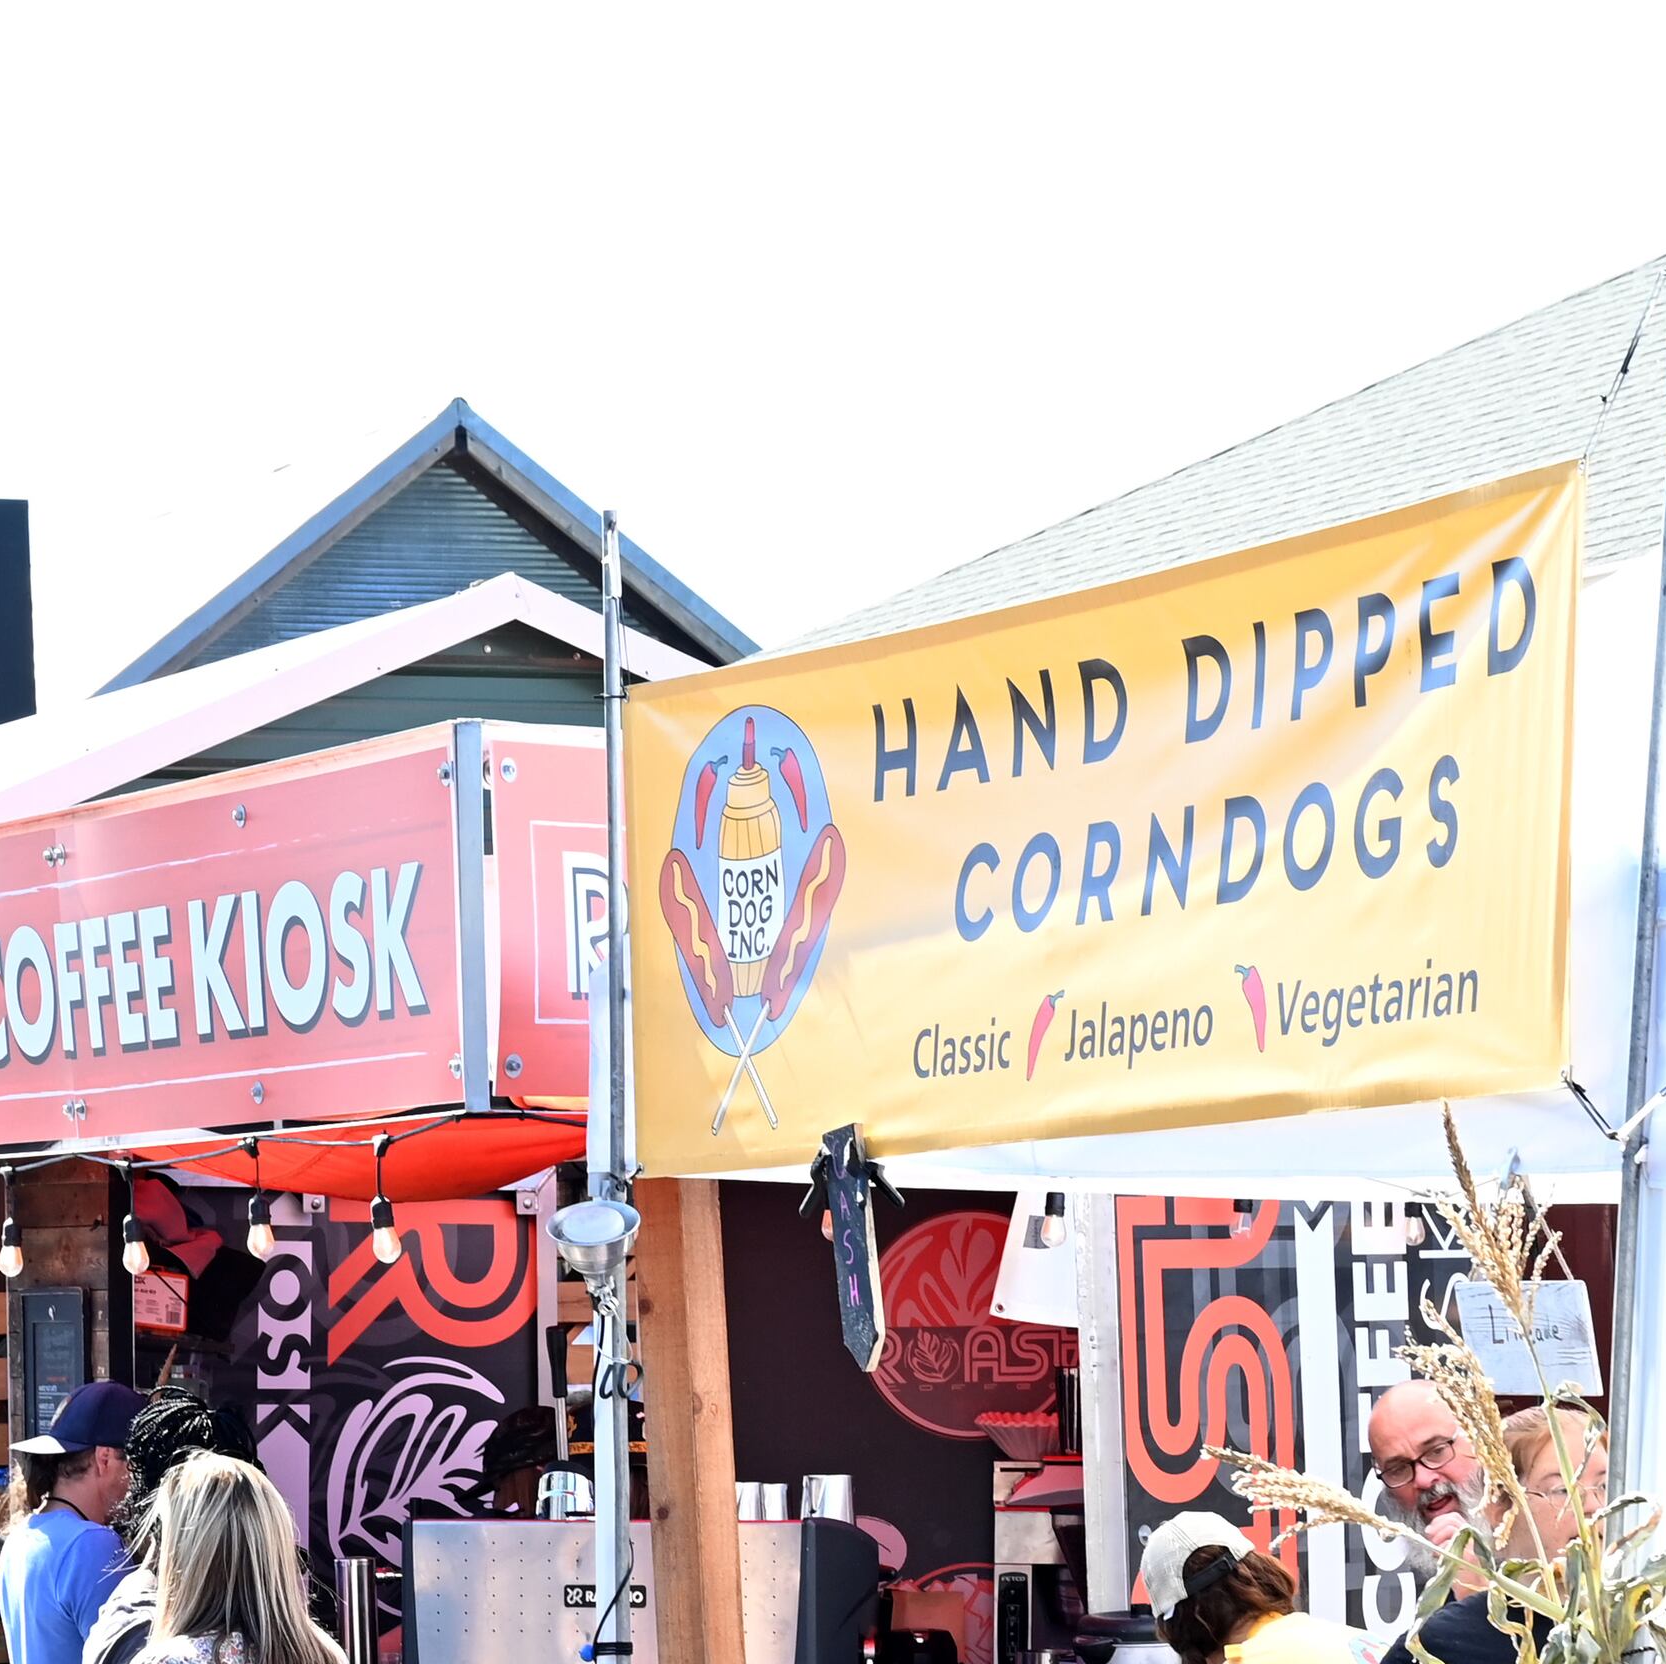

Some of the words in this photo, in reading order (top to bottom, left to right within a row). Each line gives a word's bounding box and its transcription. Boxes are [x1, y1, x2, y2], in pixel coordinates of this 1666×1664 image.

[873, 657, 1129, 803] HAND
[1181, 555, 1536, 744] DIPPED
[722, 858, 779, 899] CORN
[954, 754, 1460, 942] CORNDOGS
[186, 861, 430, 1044] KIOSK
[727, 894, 773, 929] DOG
[727, 926, 770, 960] INC.
[913, 1017, 1011, 1080] Classic
[1064, 999, 1214, 1070] Jalapeno
[1276, 957, 1479, 1048] Vegetarian
